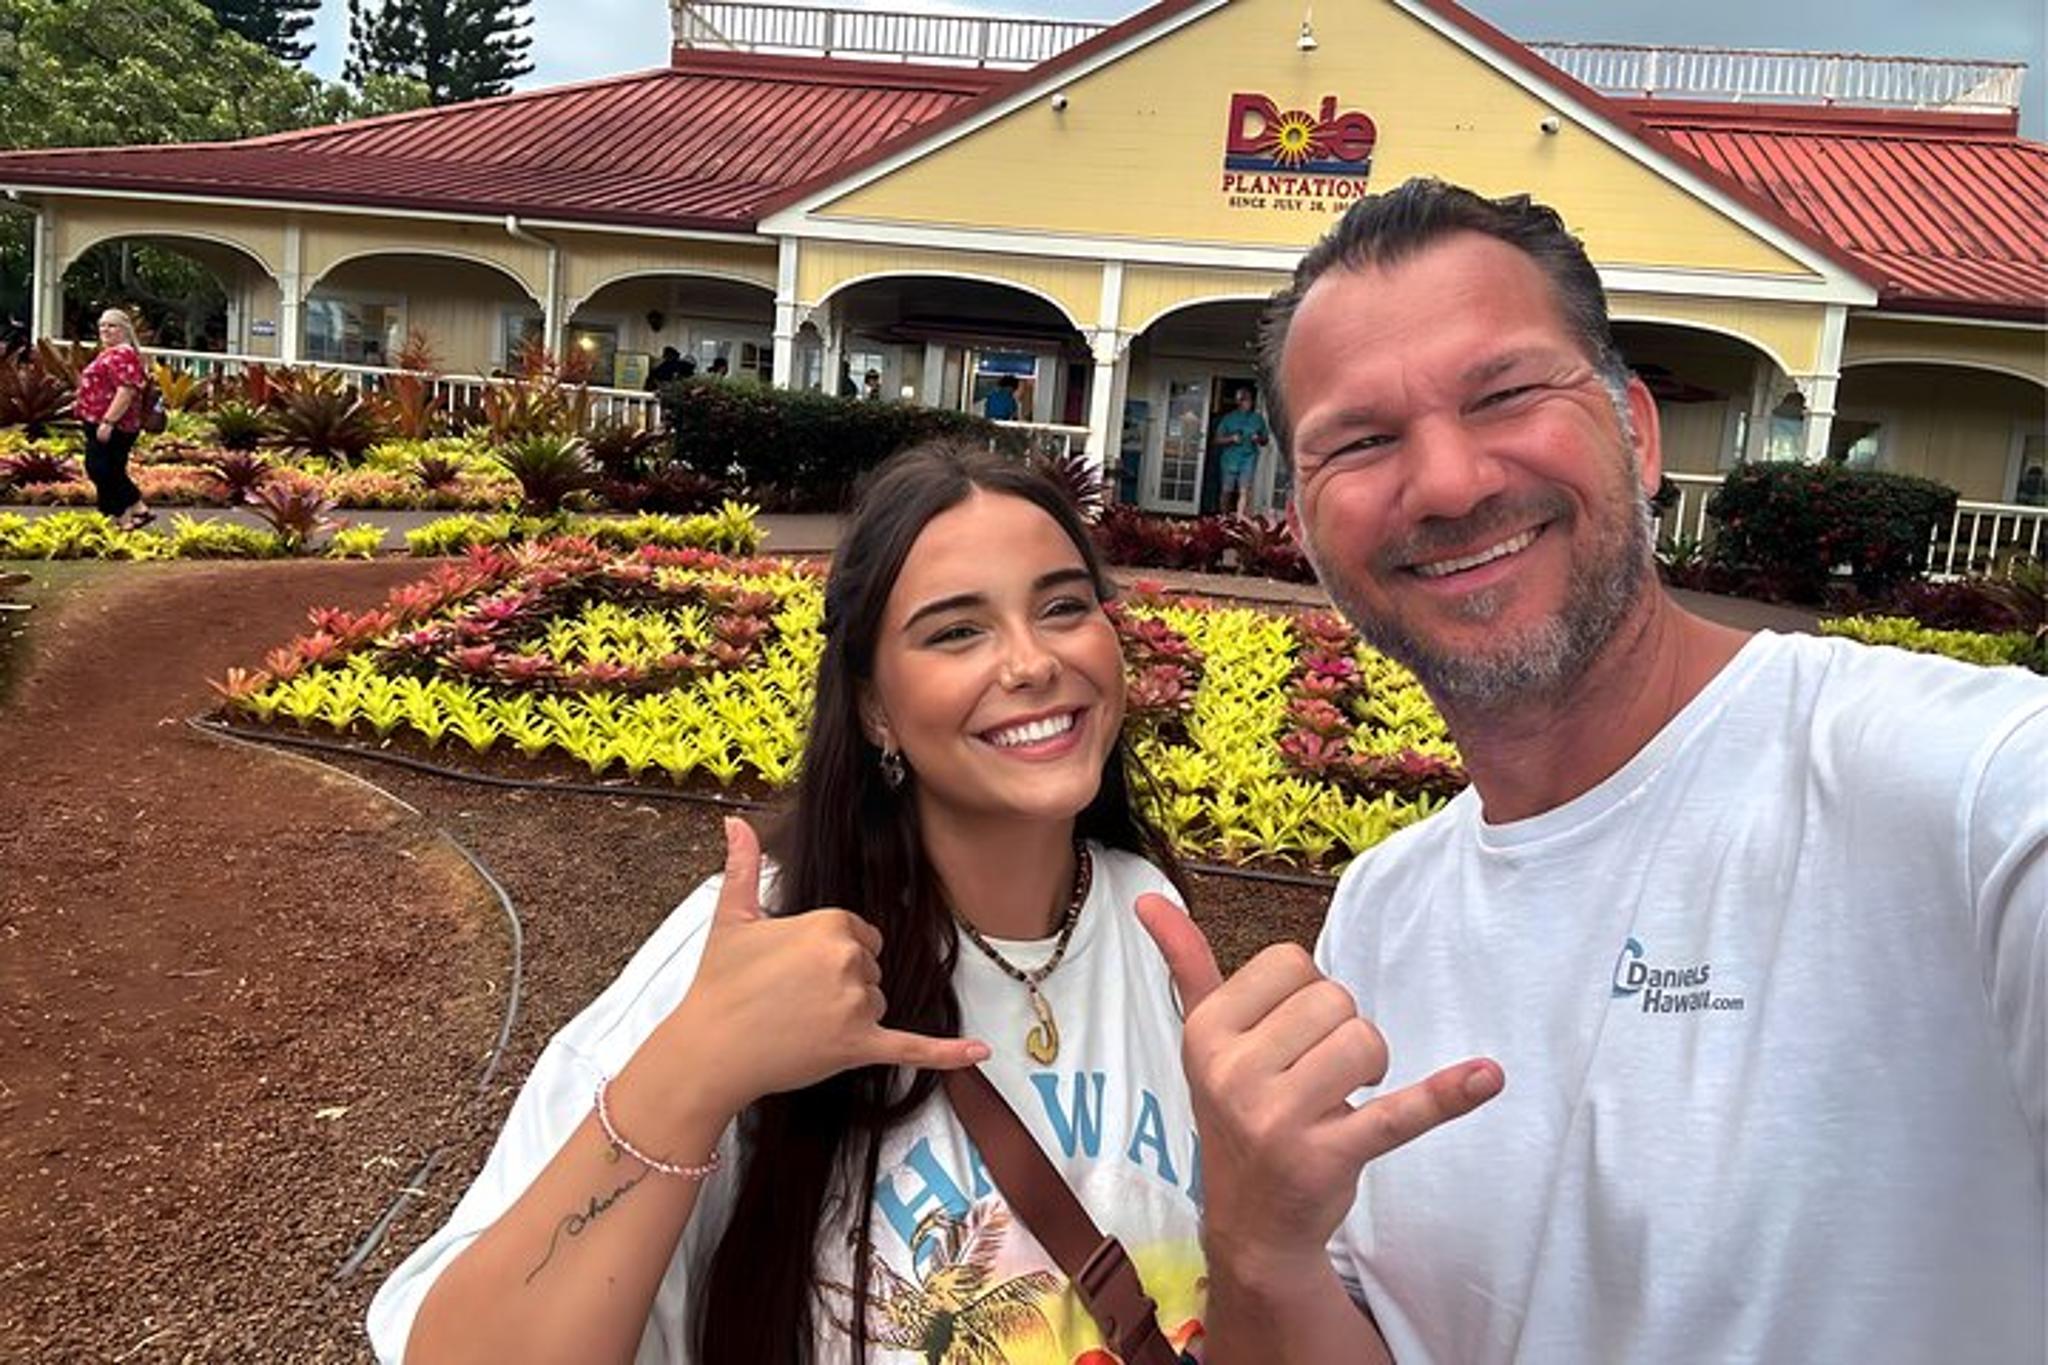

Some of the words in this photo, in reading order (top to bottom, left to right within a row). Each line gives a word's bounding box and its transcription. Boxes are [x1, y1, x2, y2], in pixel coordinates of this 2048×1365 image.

[1226, 92, 1377, 161] Dole
[1222, 174, 1368, 199] PLANTATION
[1228, 196, 1266, 209] SINCE
[1273, 198, 1302, 211] JULY
[1626, 961, 1710, 987] Daniels
